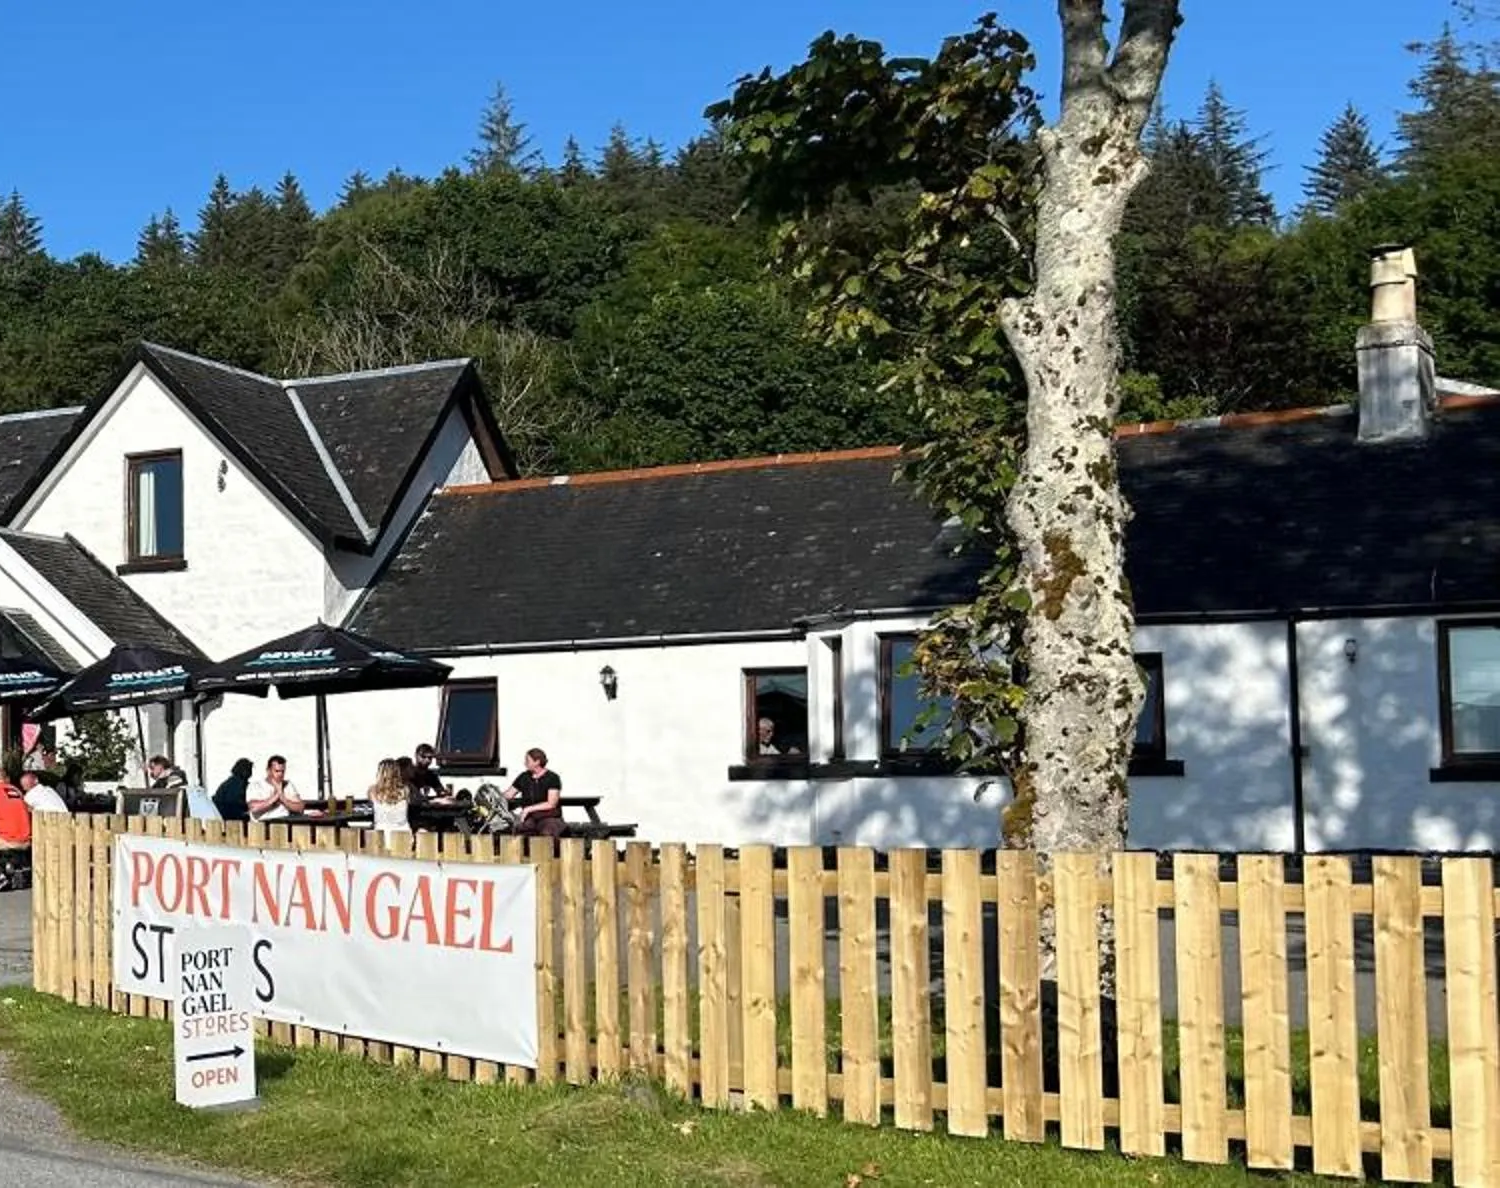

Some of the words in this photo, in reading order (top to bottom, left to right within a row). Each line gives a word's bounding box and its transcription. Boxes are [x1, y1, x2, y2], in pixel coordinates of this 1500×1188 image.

[131, 851, 240, 919] PORT
[252, 862, 354, 934] NAN
[365, 872, 513, 953] GAEL
[131, 921, 275, 1003] STS
[181, 947, 233, 972] PORT
[181, 971, 223, 995] NAN
[181, 993, 233, 1017] GAEL
[191, 1067, 238, 1089] OPEN
